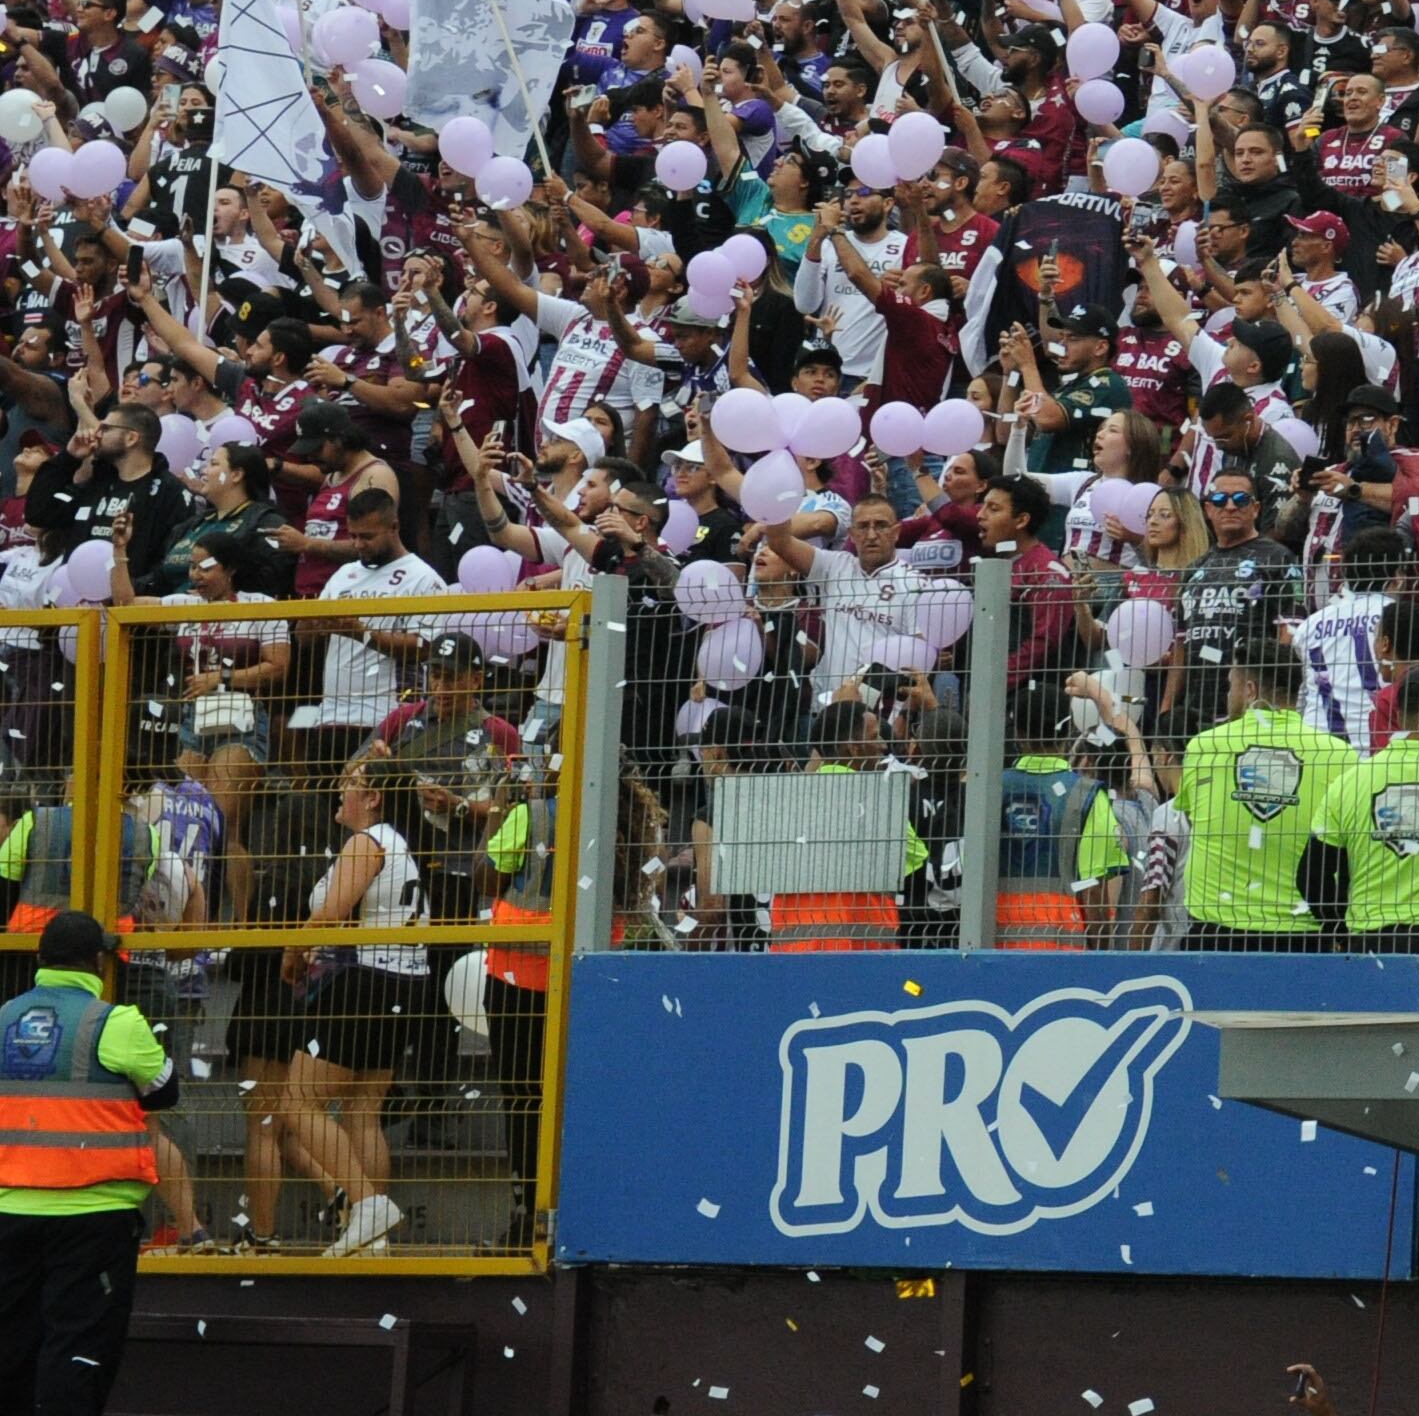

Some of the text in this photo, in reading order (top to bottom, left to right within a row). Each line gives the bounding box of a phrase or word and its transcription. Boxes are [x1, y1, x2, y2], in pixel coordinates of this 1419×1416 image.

[1296, 3, 1309, 18] S
[1313, 57, 1326, 73] S
[1370, 136, 1385, 150] S
[1180, 146, 1195, 158] BA
[1341, 154, 1374, 168] BAC
[169, 175, 188, 221] 1
[430, 232, 460, 245] LIBE
[961, 231, 977, 245] S
[242, 251, 256, 264] S
[870, 260, 891, 271] AC
[1165, 341, 1181, 357] S
[1137, 354, 1170, 373] BAC
[275, 396, 294, 411] S
[109, 498, 128, 512] BA
[327, 494, 342, 510] S
[914, 546, 953, 560] MBO
[1237, 560, 1256, 578] S
[389, 570, 406, 586] S
[881, 584, 894, 602] S
[1201, 587, 1246, 608] BAC
[1315, 614, 1381, 642] SAPRISS
[439, 639, 455, 656] S
[792, 1009, 1150, 1210] PRO
